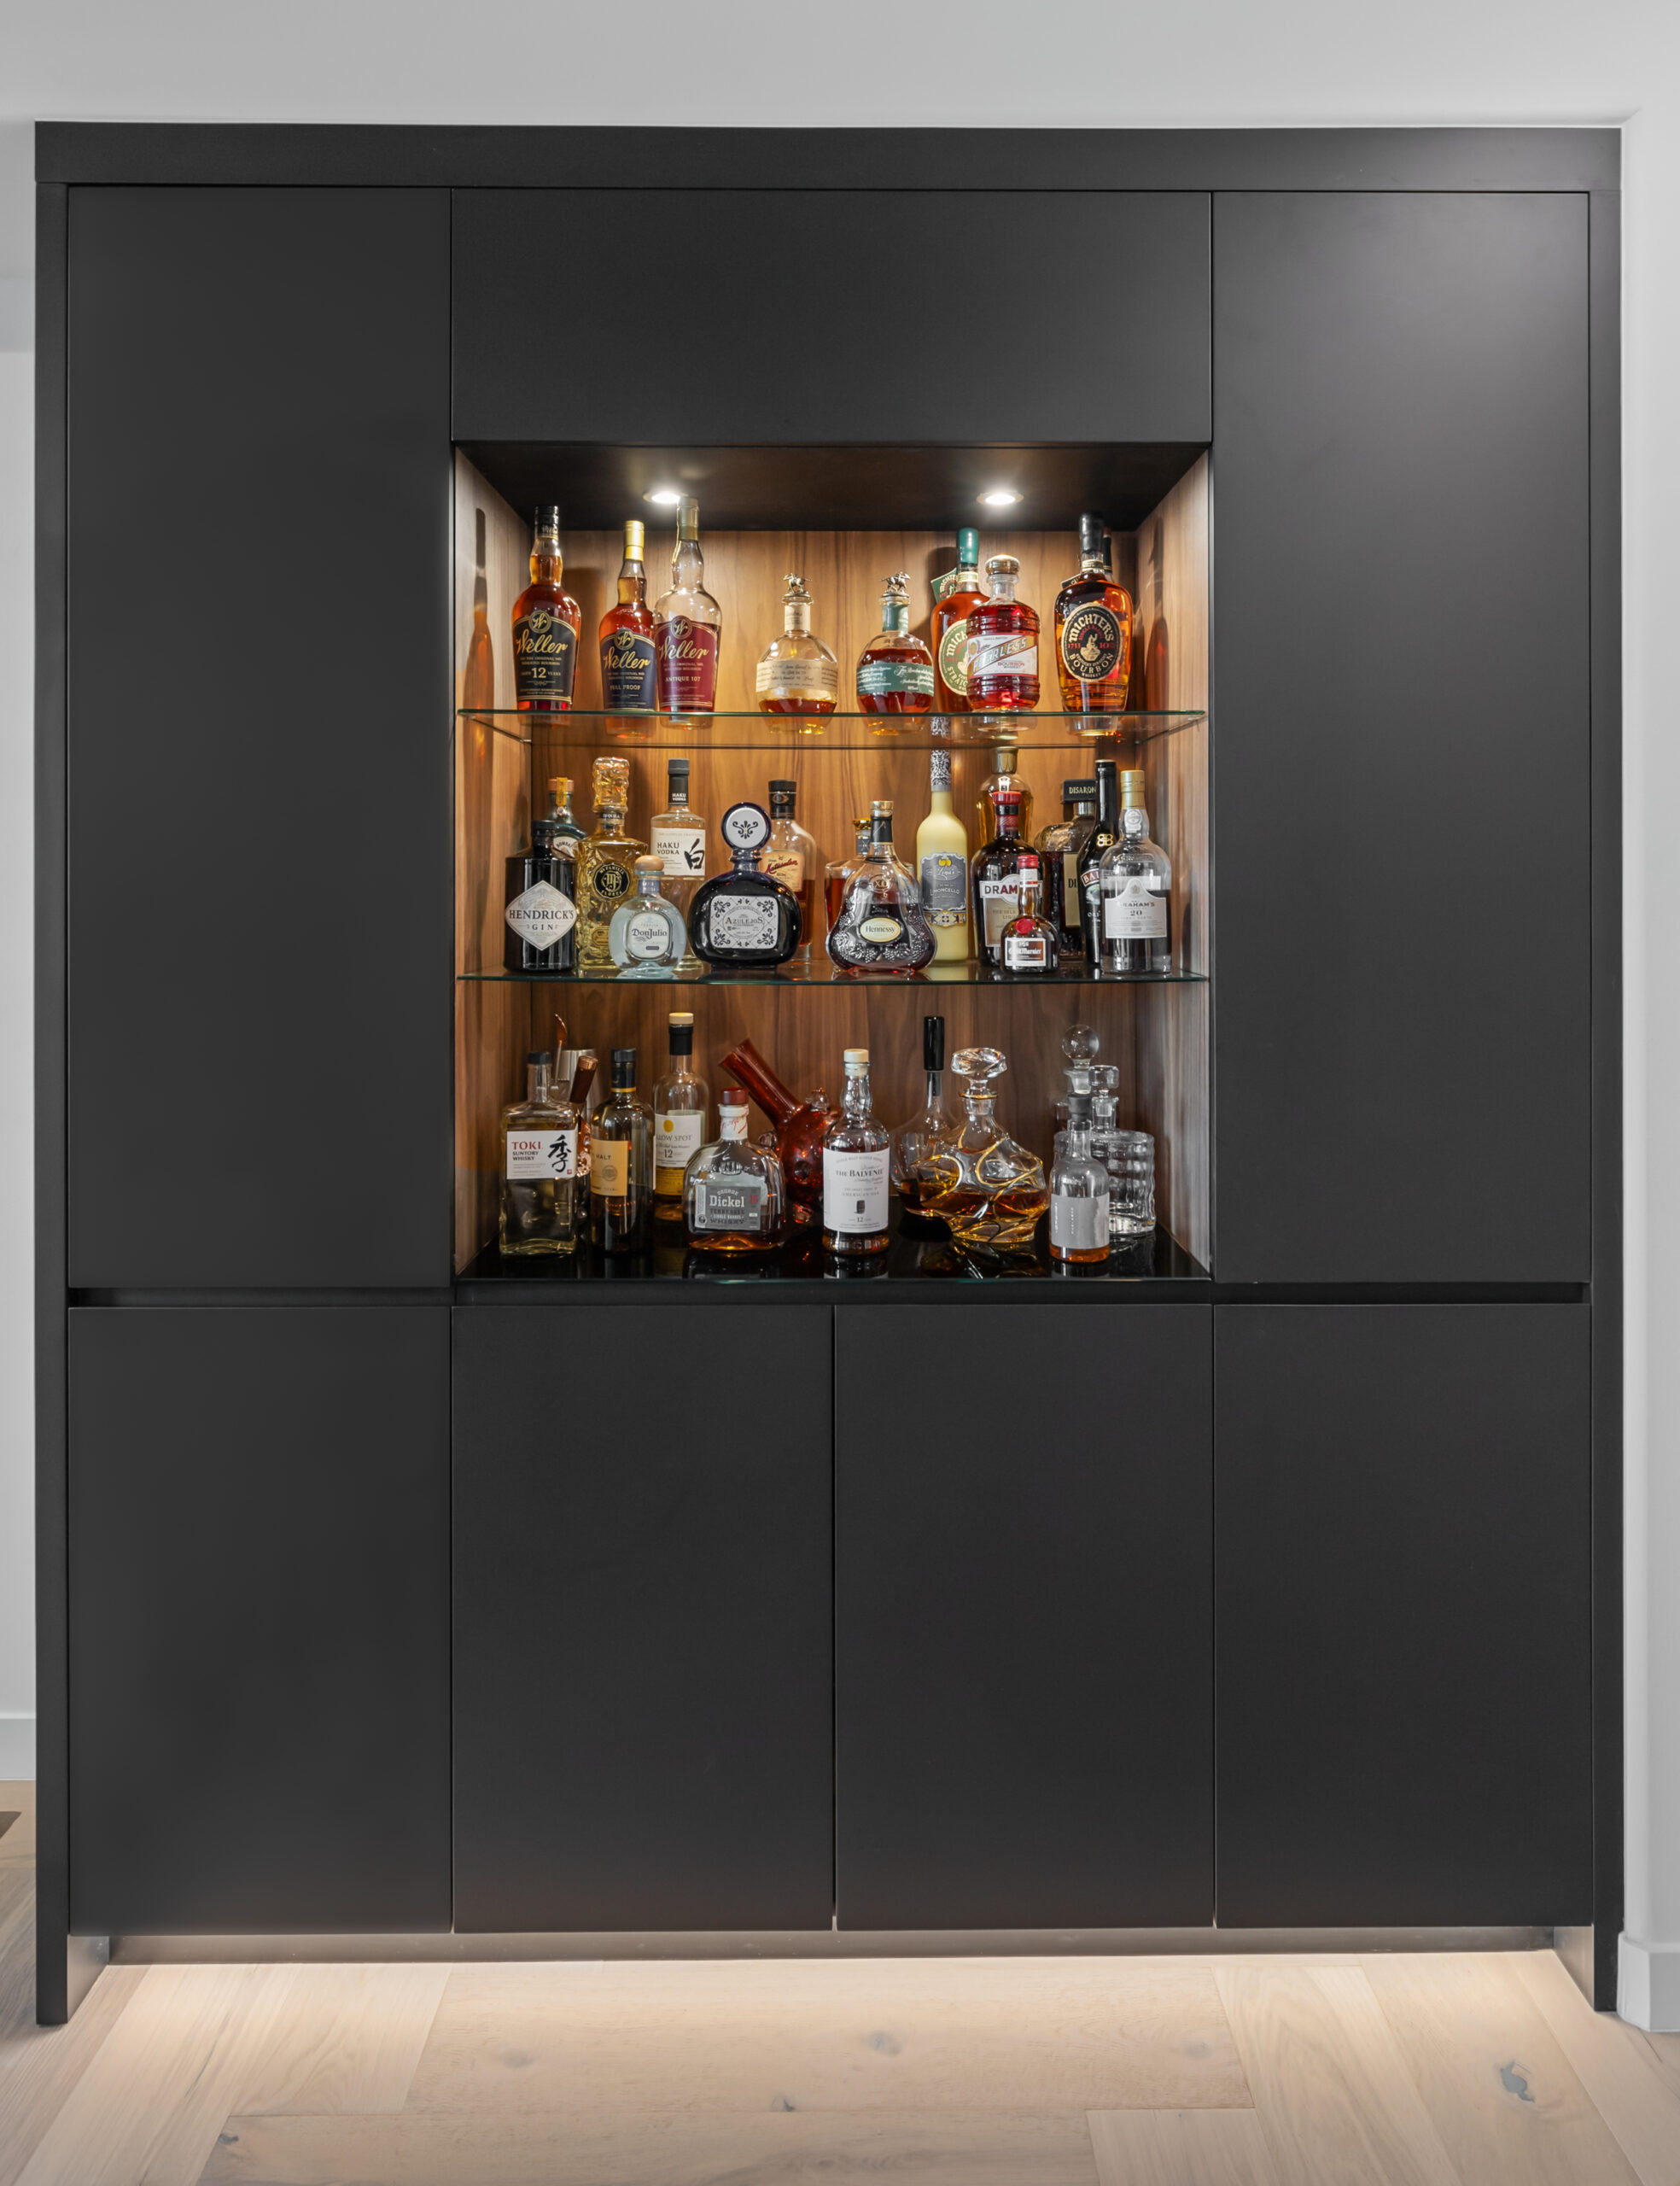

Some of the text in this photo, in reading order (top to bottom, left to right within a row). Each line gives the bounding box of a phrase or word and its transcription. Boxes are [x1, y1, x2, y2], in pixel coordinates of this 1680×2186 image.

[1068, 613, 1115, 643] MICHTER'S
[516, 628, 569, 655] Weller
[659, 635, 709, 660] Weller
[603, 646, 651, 669] Weller
[1069, 652, 1114, 674] BOURBON
[531, 667, 547, 678] 12
[984, 885, 1018, 894] DRAM
[509, 909, 575, 920] HENDRICK'S
[866, 926, 895, 934] Hennessy
[511, 1141, 541, 1150] TOKI
[663, 1149, 674, 1158] 12
[849, 1168, 884, 1177] BALVENIE
[709, 1195, 745, 1207] Dickel
